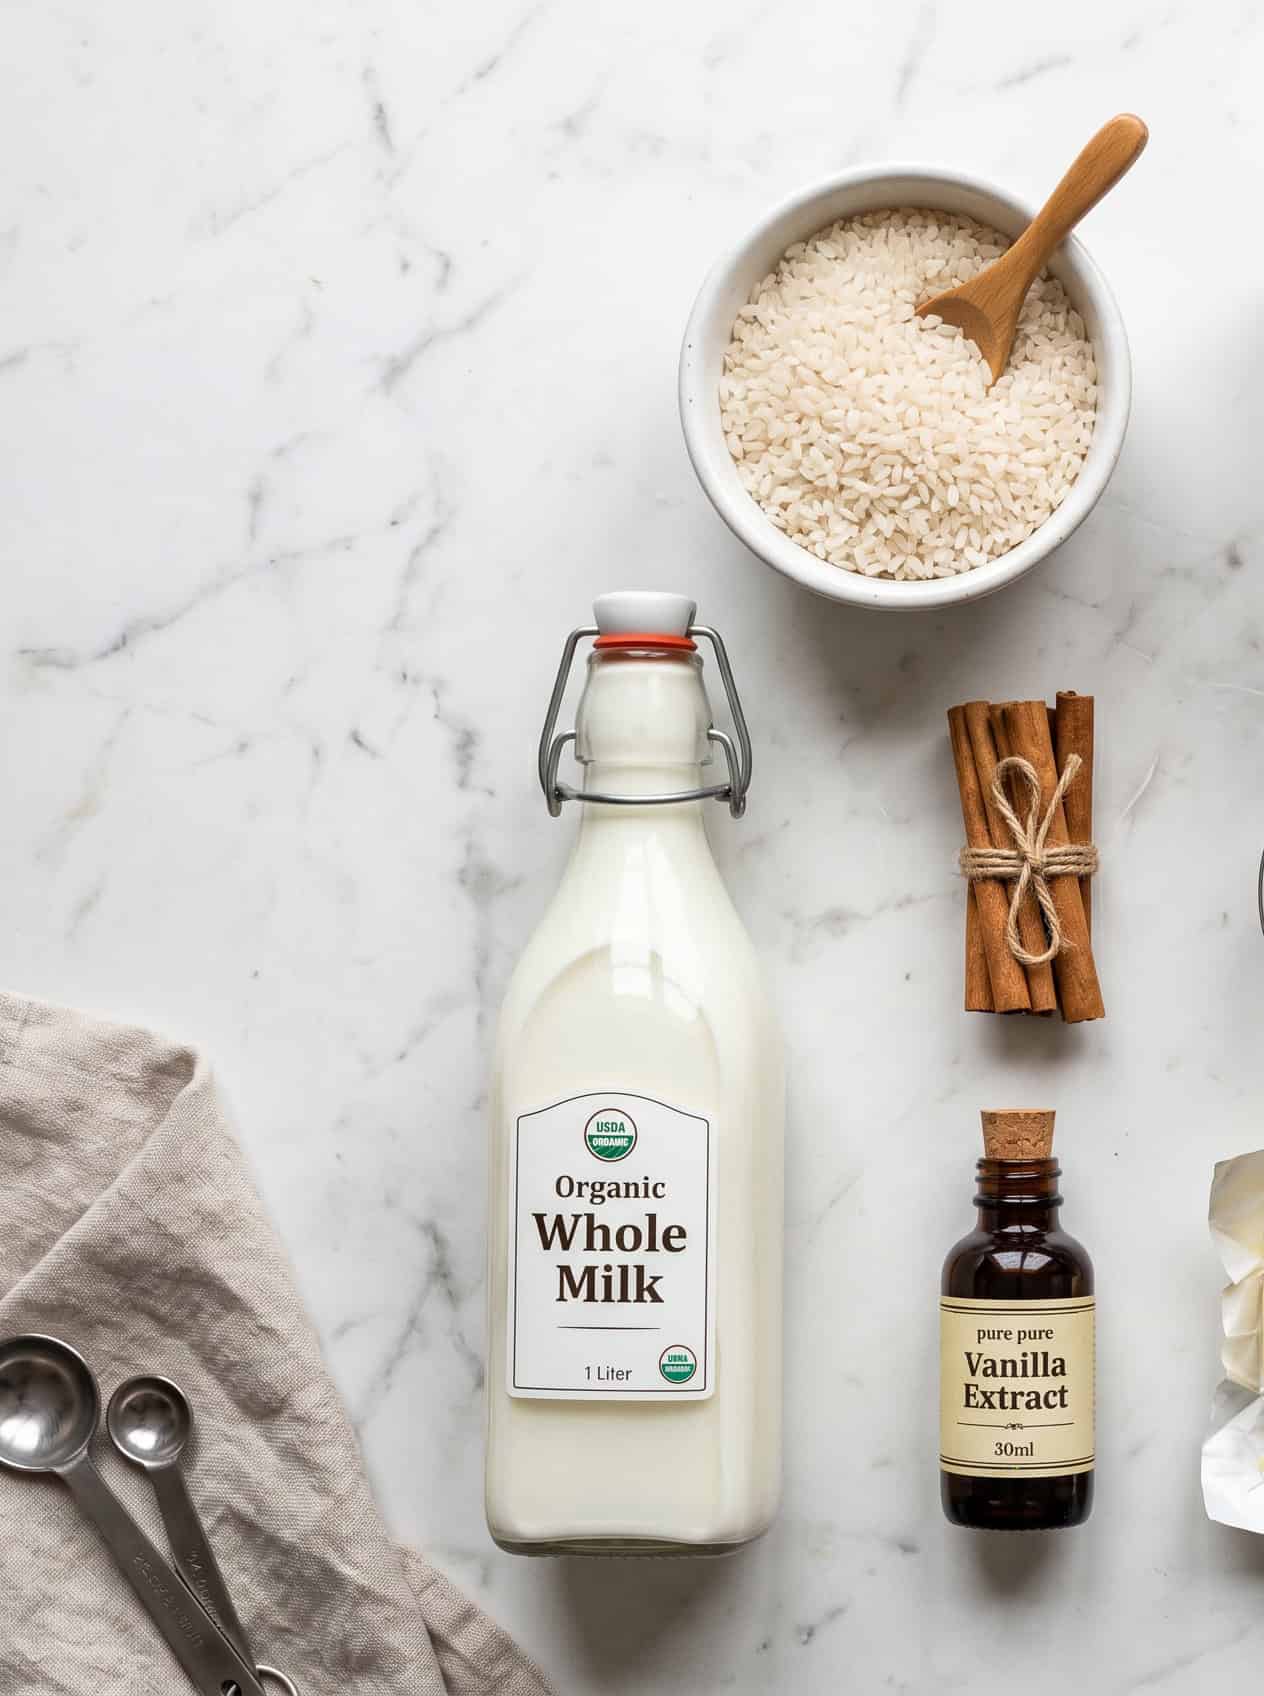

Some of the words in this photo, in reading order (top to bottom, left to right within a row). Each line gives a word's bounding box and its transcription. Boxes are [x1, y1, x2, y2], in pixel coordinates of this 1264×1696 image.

[596, 1121, 626, 1134] USDA
[555, 1175, 666, 1205] Organic
[532, 1212, 687, 1253] Whole
[555, 1263, 664, 1304] Milk
[977, 1329, 1013, 1344] pure
[1017, 1328, 1054, 1344] pure
[584, 1366, 591, 1380] 1
[597, 1366, 632, 1381] Liter
[964, 1351, 1067, 1378] Vanilla
[963, 1383, 1069, 1410] Extract
[994, 1441, 1035, 1457] 30ml
